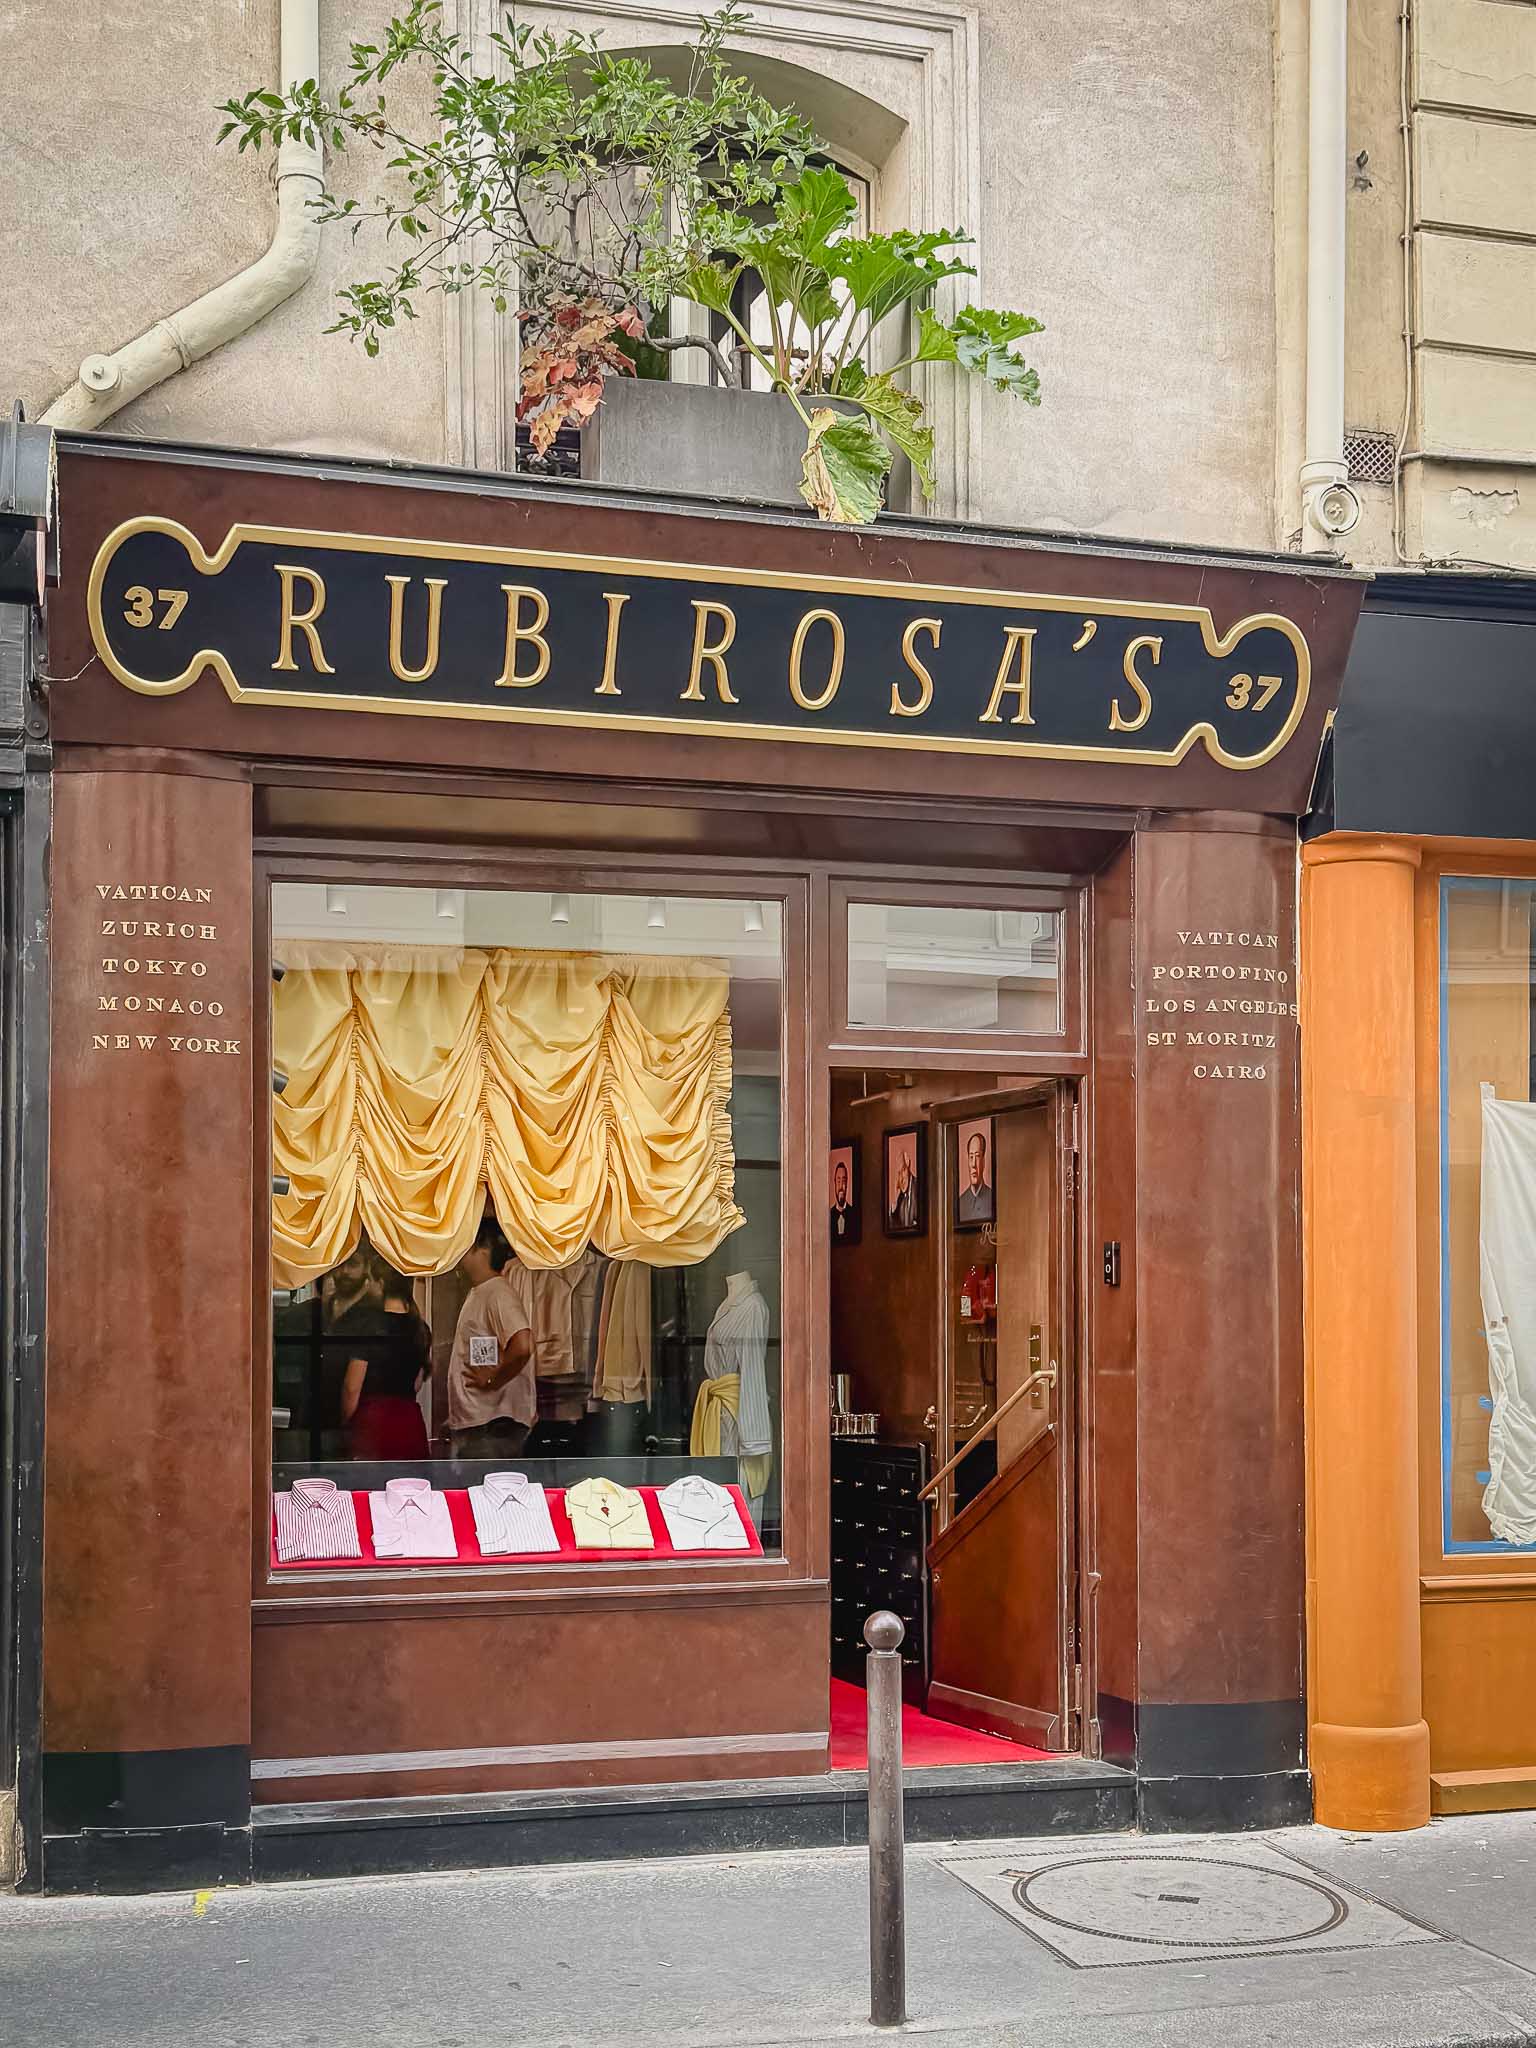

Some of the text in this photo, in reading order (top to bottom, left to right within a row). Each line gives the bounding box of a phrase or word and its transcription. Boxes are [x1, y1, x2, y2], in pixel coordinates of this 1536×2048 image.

[123, 586, 190, 631] 37
[271, 564, 1164, 732] RUBIROSA'S
[1225, 673, 1283, 712] 37
[96, 885, 213, 904] VATICAN
[101, 920, 217, 940] ZURICH
[1176, 931, 1279, 949] VATICAN
[102, 958, 207, 977] TOKYO
[1152, 965, 1288, 984] PORTOFINO
[97, 996, 224, 1016] MONACO
[1146, 999, 1298, 1018] LOS ANGELES
[92, 1034, 241, 1055] NEW YORK
[1147, 1032, 1276, 1049] ST MORITZ
[1193, 1065, 1267, 1080] CAIRO
